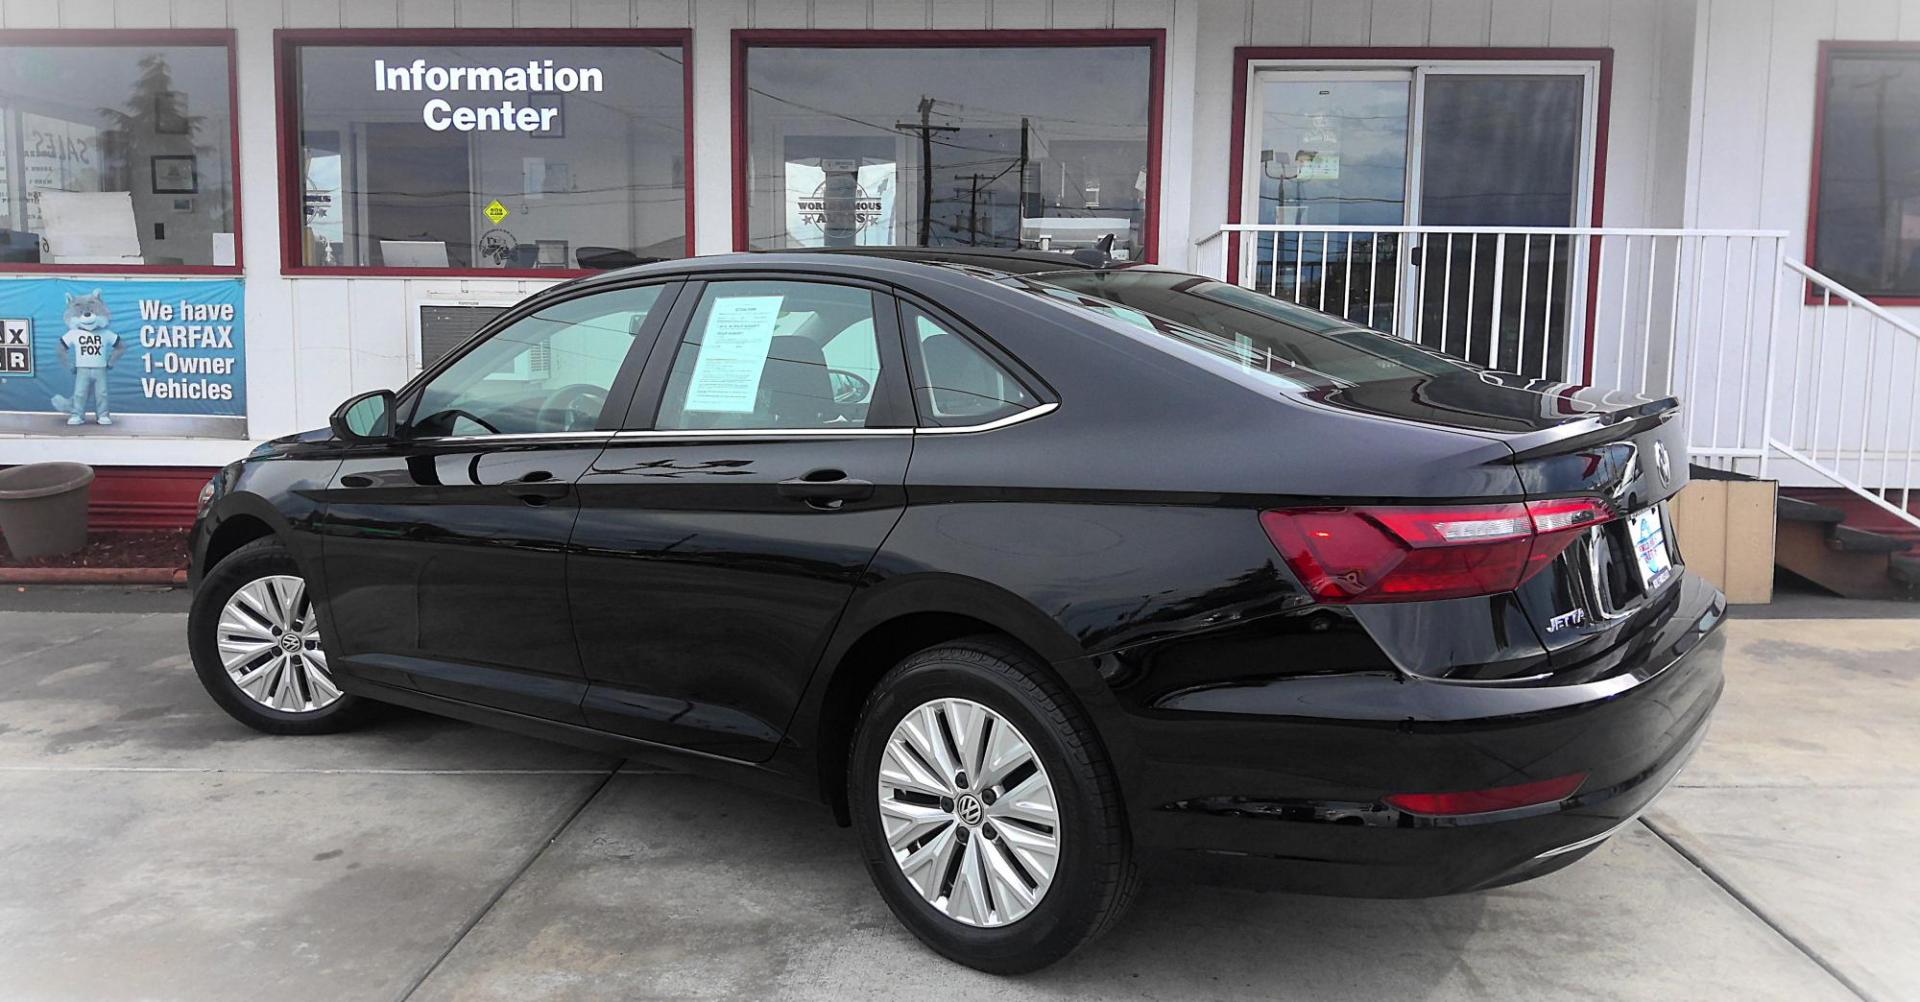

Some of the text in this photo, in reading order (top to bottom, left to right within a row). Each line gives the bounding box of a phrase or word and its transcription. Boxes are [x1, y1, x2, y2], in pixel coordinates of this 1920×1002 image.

[374, 59, 603, 92] Information
[423, 98, 558, 132] Center
[139, 299, 234, 321] We have
[78, 335, 102, 345] CAR
[139, 325, 233, 348] CARFAX
[80, 346, 102, 356] FOX
[141, 352, 235, 375] 1-Owner
[141, 377, 233, 400] Vehicles
[1545, 607, 1585, 633] JETTA
